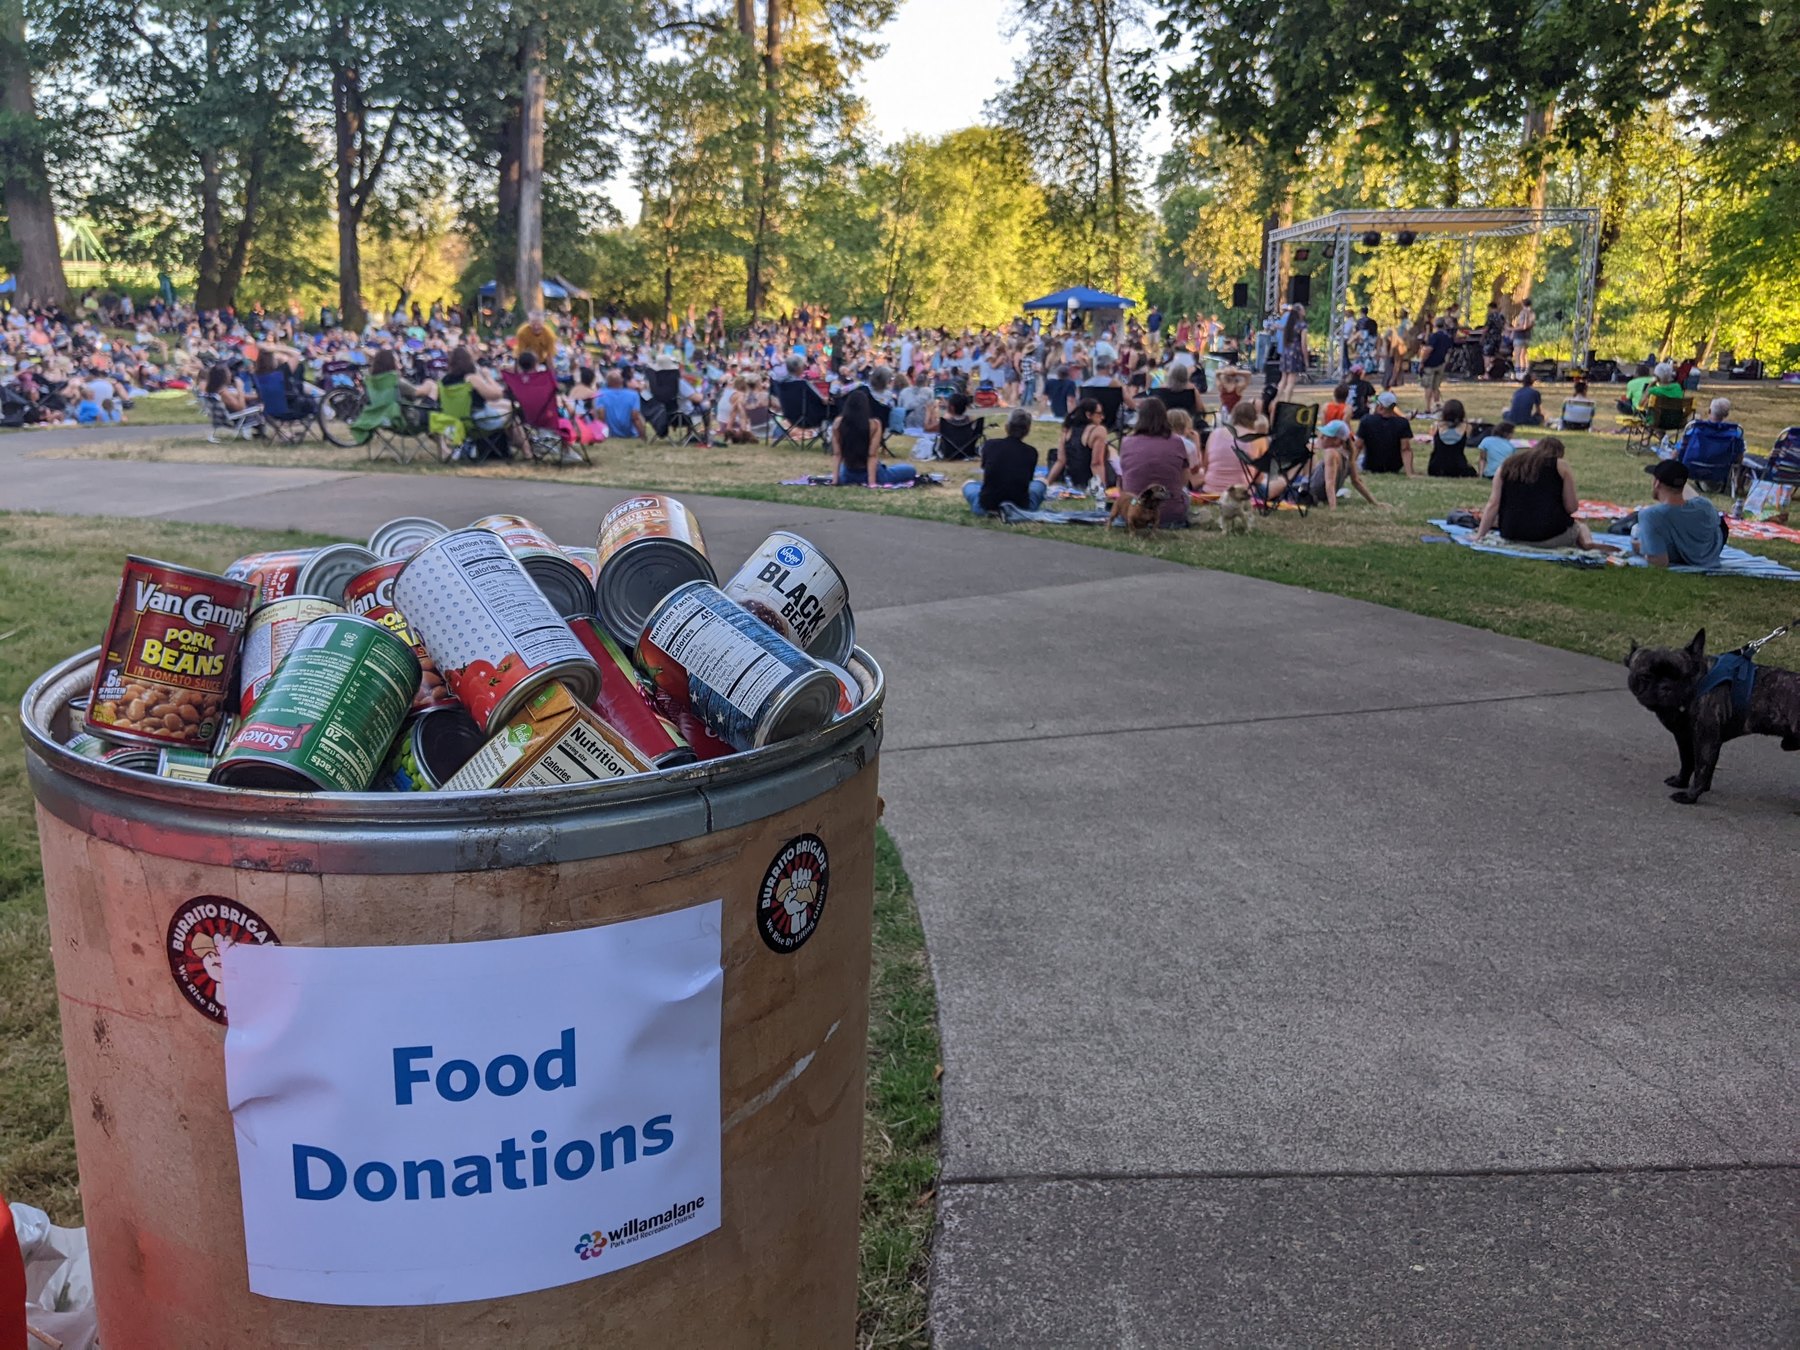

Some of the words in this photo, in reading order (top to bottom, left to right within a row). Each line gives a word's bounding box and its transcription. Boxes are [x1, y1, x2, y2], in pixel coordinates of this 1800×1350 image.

[449, 540, 478, 553] Nutrition
[468, 564, 500, 576] Calories
[136, 580, 181, 615] Van
[183, 594, 248, 635] Camp's
[756, 559, 826, 632] BLACK
[390, 622, 407, 631] AND
[649, 609, 674, 641] Nutrition
[672, 594, 692, 610] Facts
[670, 627, 694, 657] Calories
[698, 608, 713, 621] 45
[779, 601, 812, 647] BEANS
[165, 628, 216, 652] PORK
[179, 644, 200, 654] AND
[660, 631, 674, 648] Serving
[671, 621, 680, 631] size
[140, 638, 225, 677] BEANS
[133, 665, 145, 676] IN
[149, 668, 192, 687] TOMATO
[194, 678, 222, 691] SAUCE
[325, 727, 341, 741] 20
[562, 739, 578, 755] Serving
[577, 752, 587, 762] size
[569, 725, 626, 776] Nutrition
[310, 754, 336, 777] Facts
[489, 740, 506, 769] Masterpiece
[543, 755, 571, 781] Calories
[529, 771, 540, 780] Total
[761, 847, 795, 909] BURRITO
[796, 840, 827, 873] BRIGADE
[172, 904, 218, 951] BURRITO
[220, 905, 275, 946] BRIGA
[765, 918, 774, 933] We
[772, 931, 785, 945] Rise
[178, 964, 189, 982] We
[187, 983, 206, 1005] Rise
[207, 1003, 221, 1017] By
[392, 1026, 577, 1106] Food
[291, 1113, 675, 1203] Donations
[608, 1196, 705, 1242] willamalane
[610, 1237, 625, 1249] Park
[626, 1234, 639, 1244] and
[640, 1222, 674, 1239] Recreation
[674, 1212, 696, 1226] District
